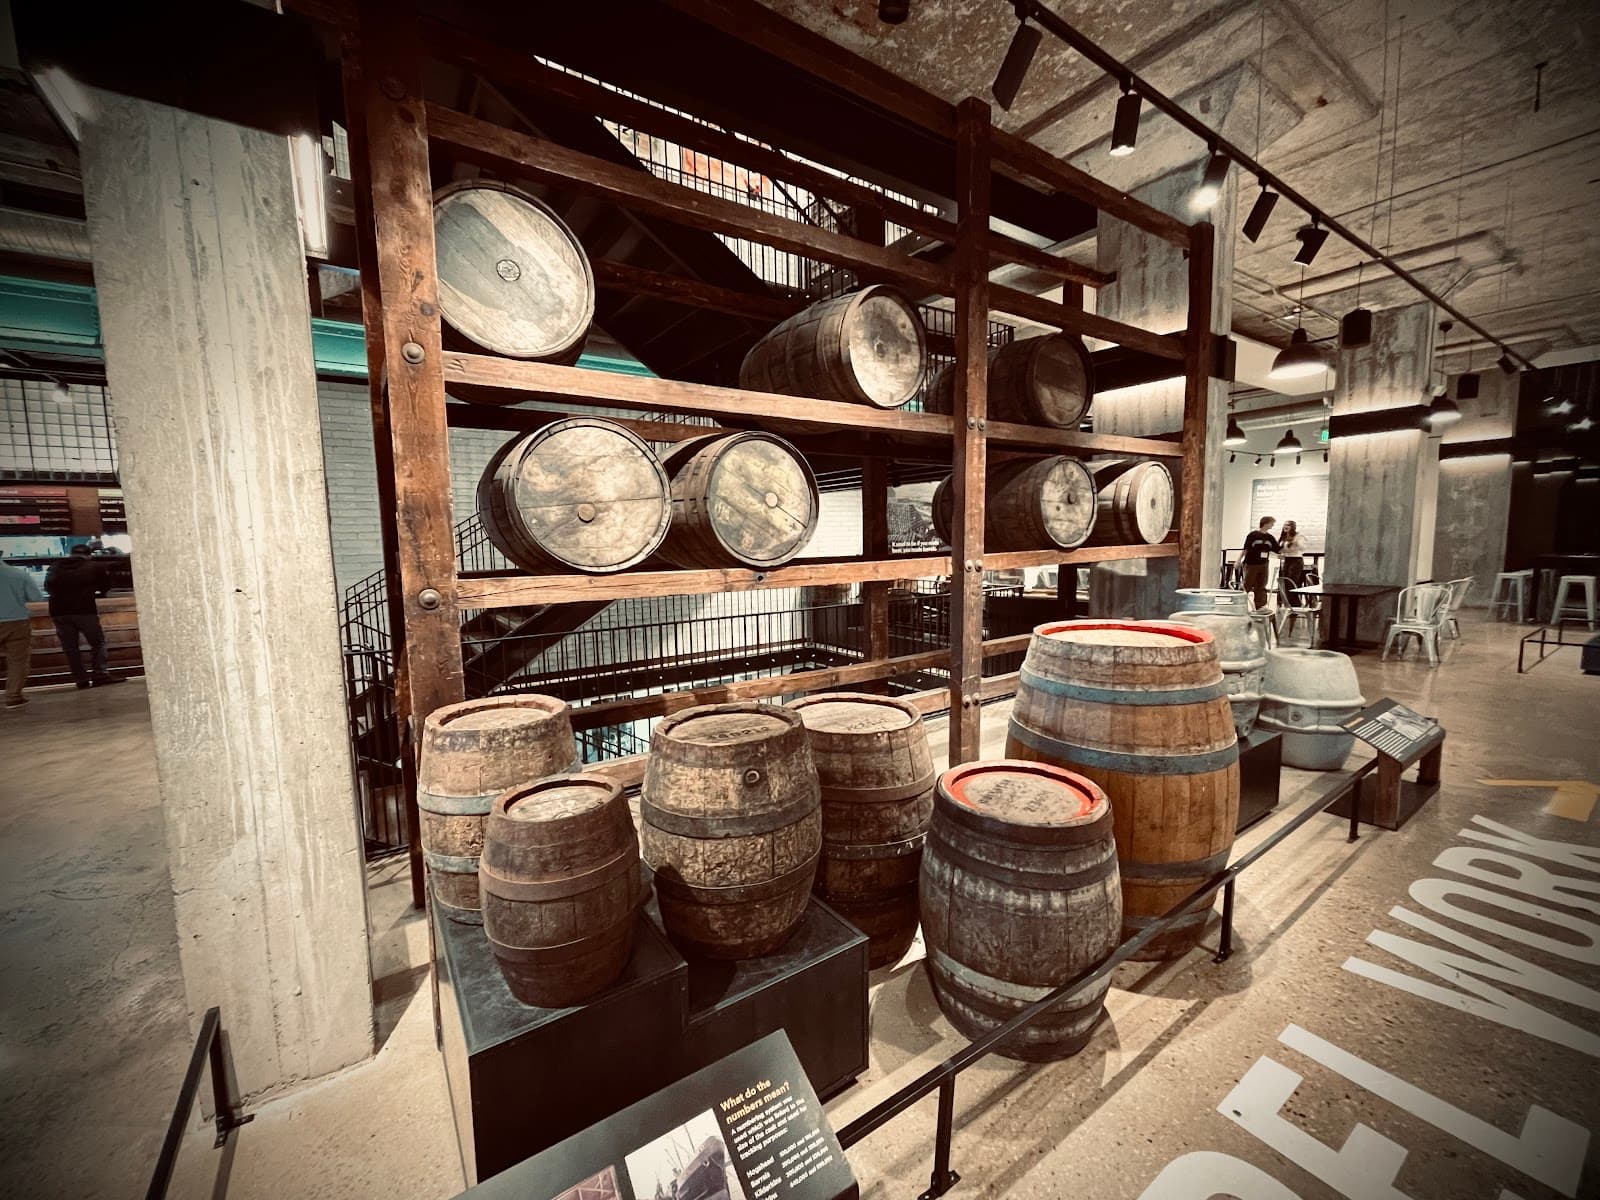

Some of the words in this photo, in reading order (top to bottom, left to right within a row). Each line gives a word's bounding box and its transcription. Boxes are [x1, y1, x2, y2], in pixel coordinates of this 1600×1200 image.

[720, 1094, 745, 1112] What
[745, 1088, 756, 1099] do
[756, 1079, 772, 1092] the
[726, 1099, 763, 1124] numbers
[764, 1081, 790, 1102] mean?
[731, 1128, 736, 1136] A
[736, 1113, 764, 1132] numbering
[765, 1102, 782, 1118] system
[734, 1134, 748, 1144] used
[748, 1122, 764, 1137] which
[764, 1116, 774, 1126] was
[737, 1142, 748, 1152] size
[748, 1136, 755, 1145] of
[755, 1130, 764, 1140] the
[765, 1124, 777, 1134] cask
[777, 1118, 788, 1128] and
[739, 1143, 763, 1160] tracking
[746, 1156, 775, 1178] Hogshead
